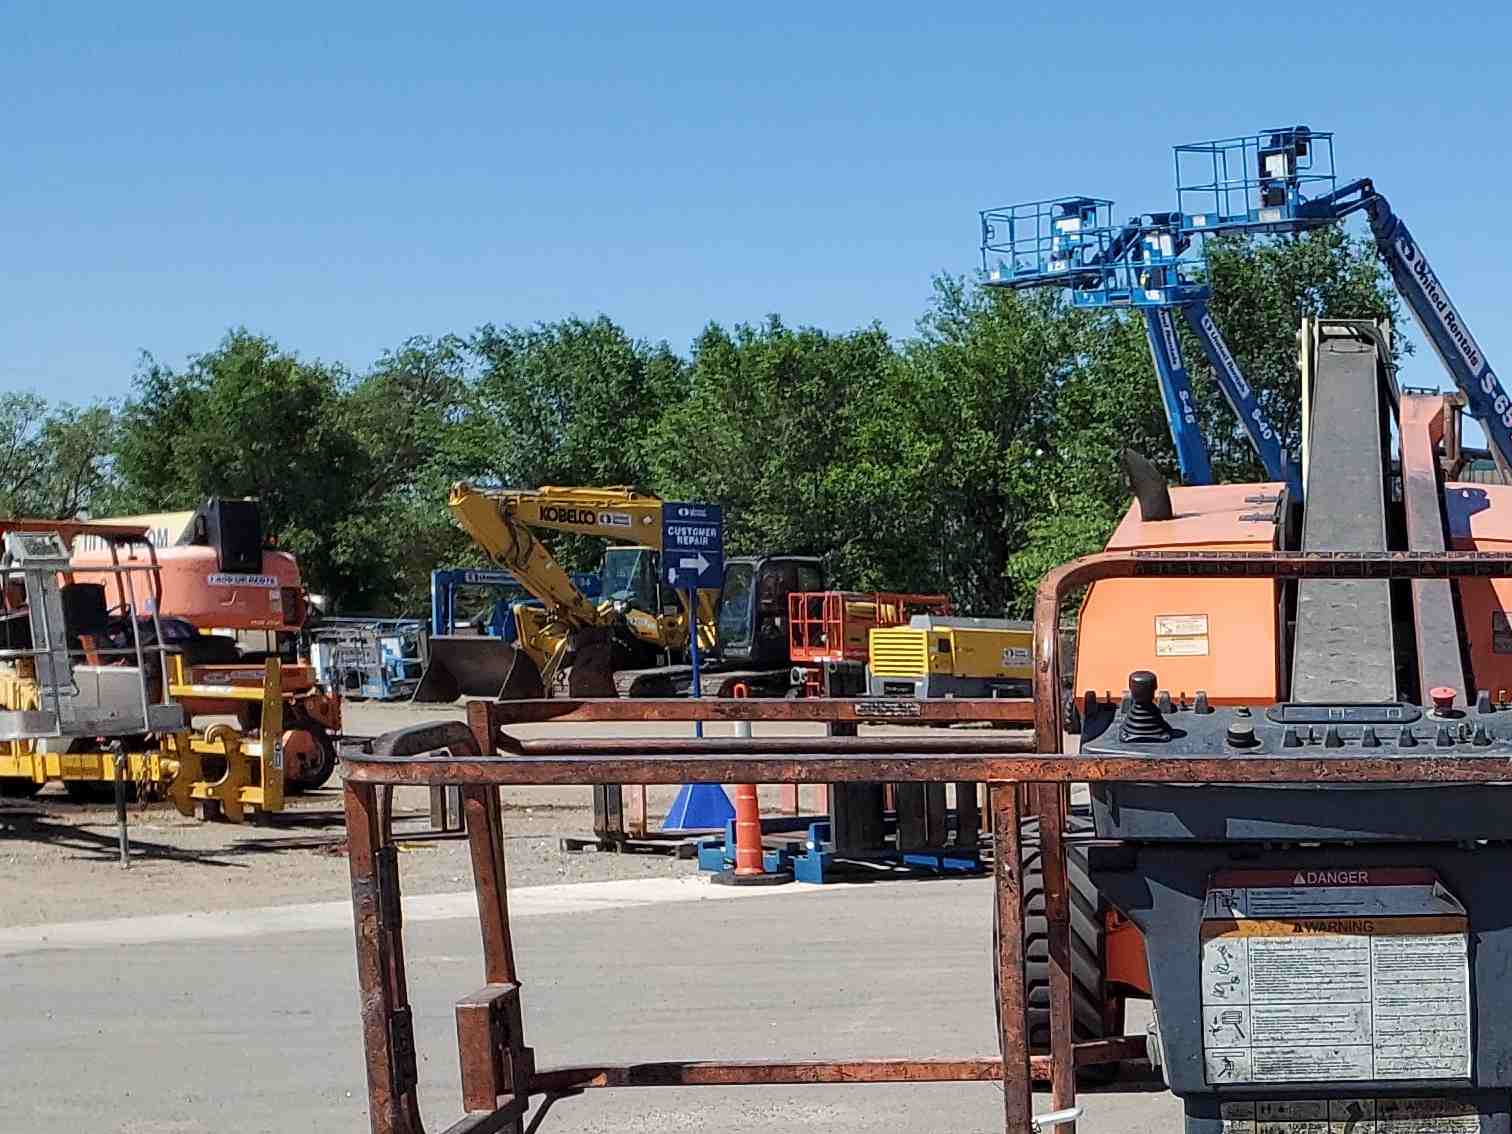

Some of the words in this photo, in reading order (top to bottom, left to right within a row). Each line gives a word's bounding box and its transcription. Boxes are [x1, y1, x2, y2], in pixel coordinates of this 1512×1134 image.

[1413, 256, 1447, 313] United
[1443, 306, 1480, 368] Rentals
[1251, 408, 1273, 440] S-40
[539, 505, 597, 526] KOBELCO
[667, 526, 717, 537] CUSTOMER
[676, 536, 709, 545] REPAIR
[1307, 871, 1369, 885] DANGER
[1305, 920, 1375, 933] WARNING
